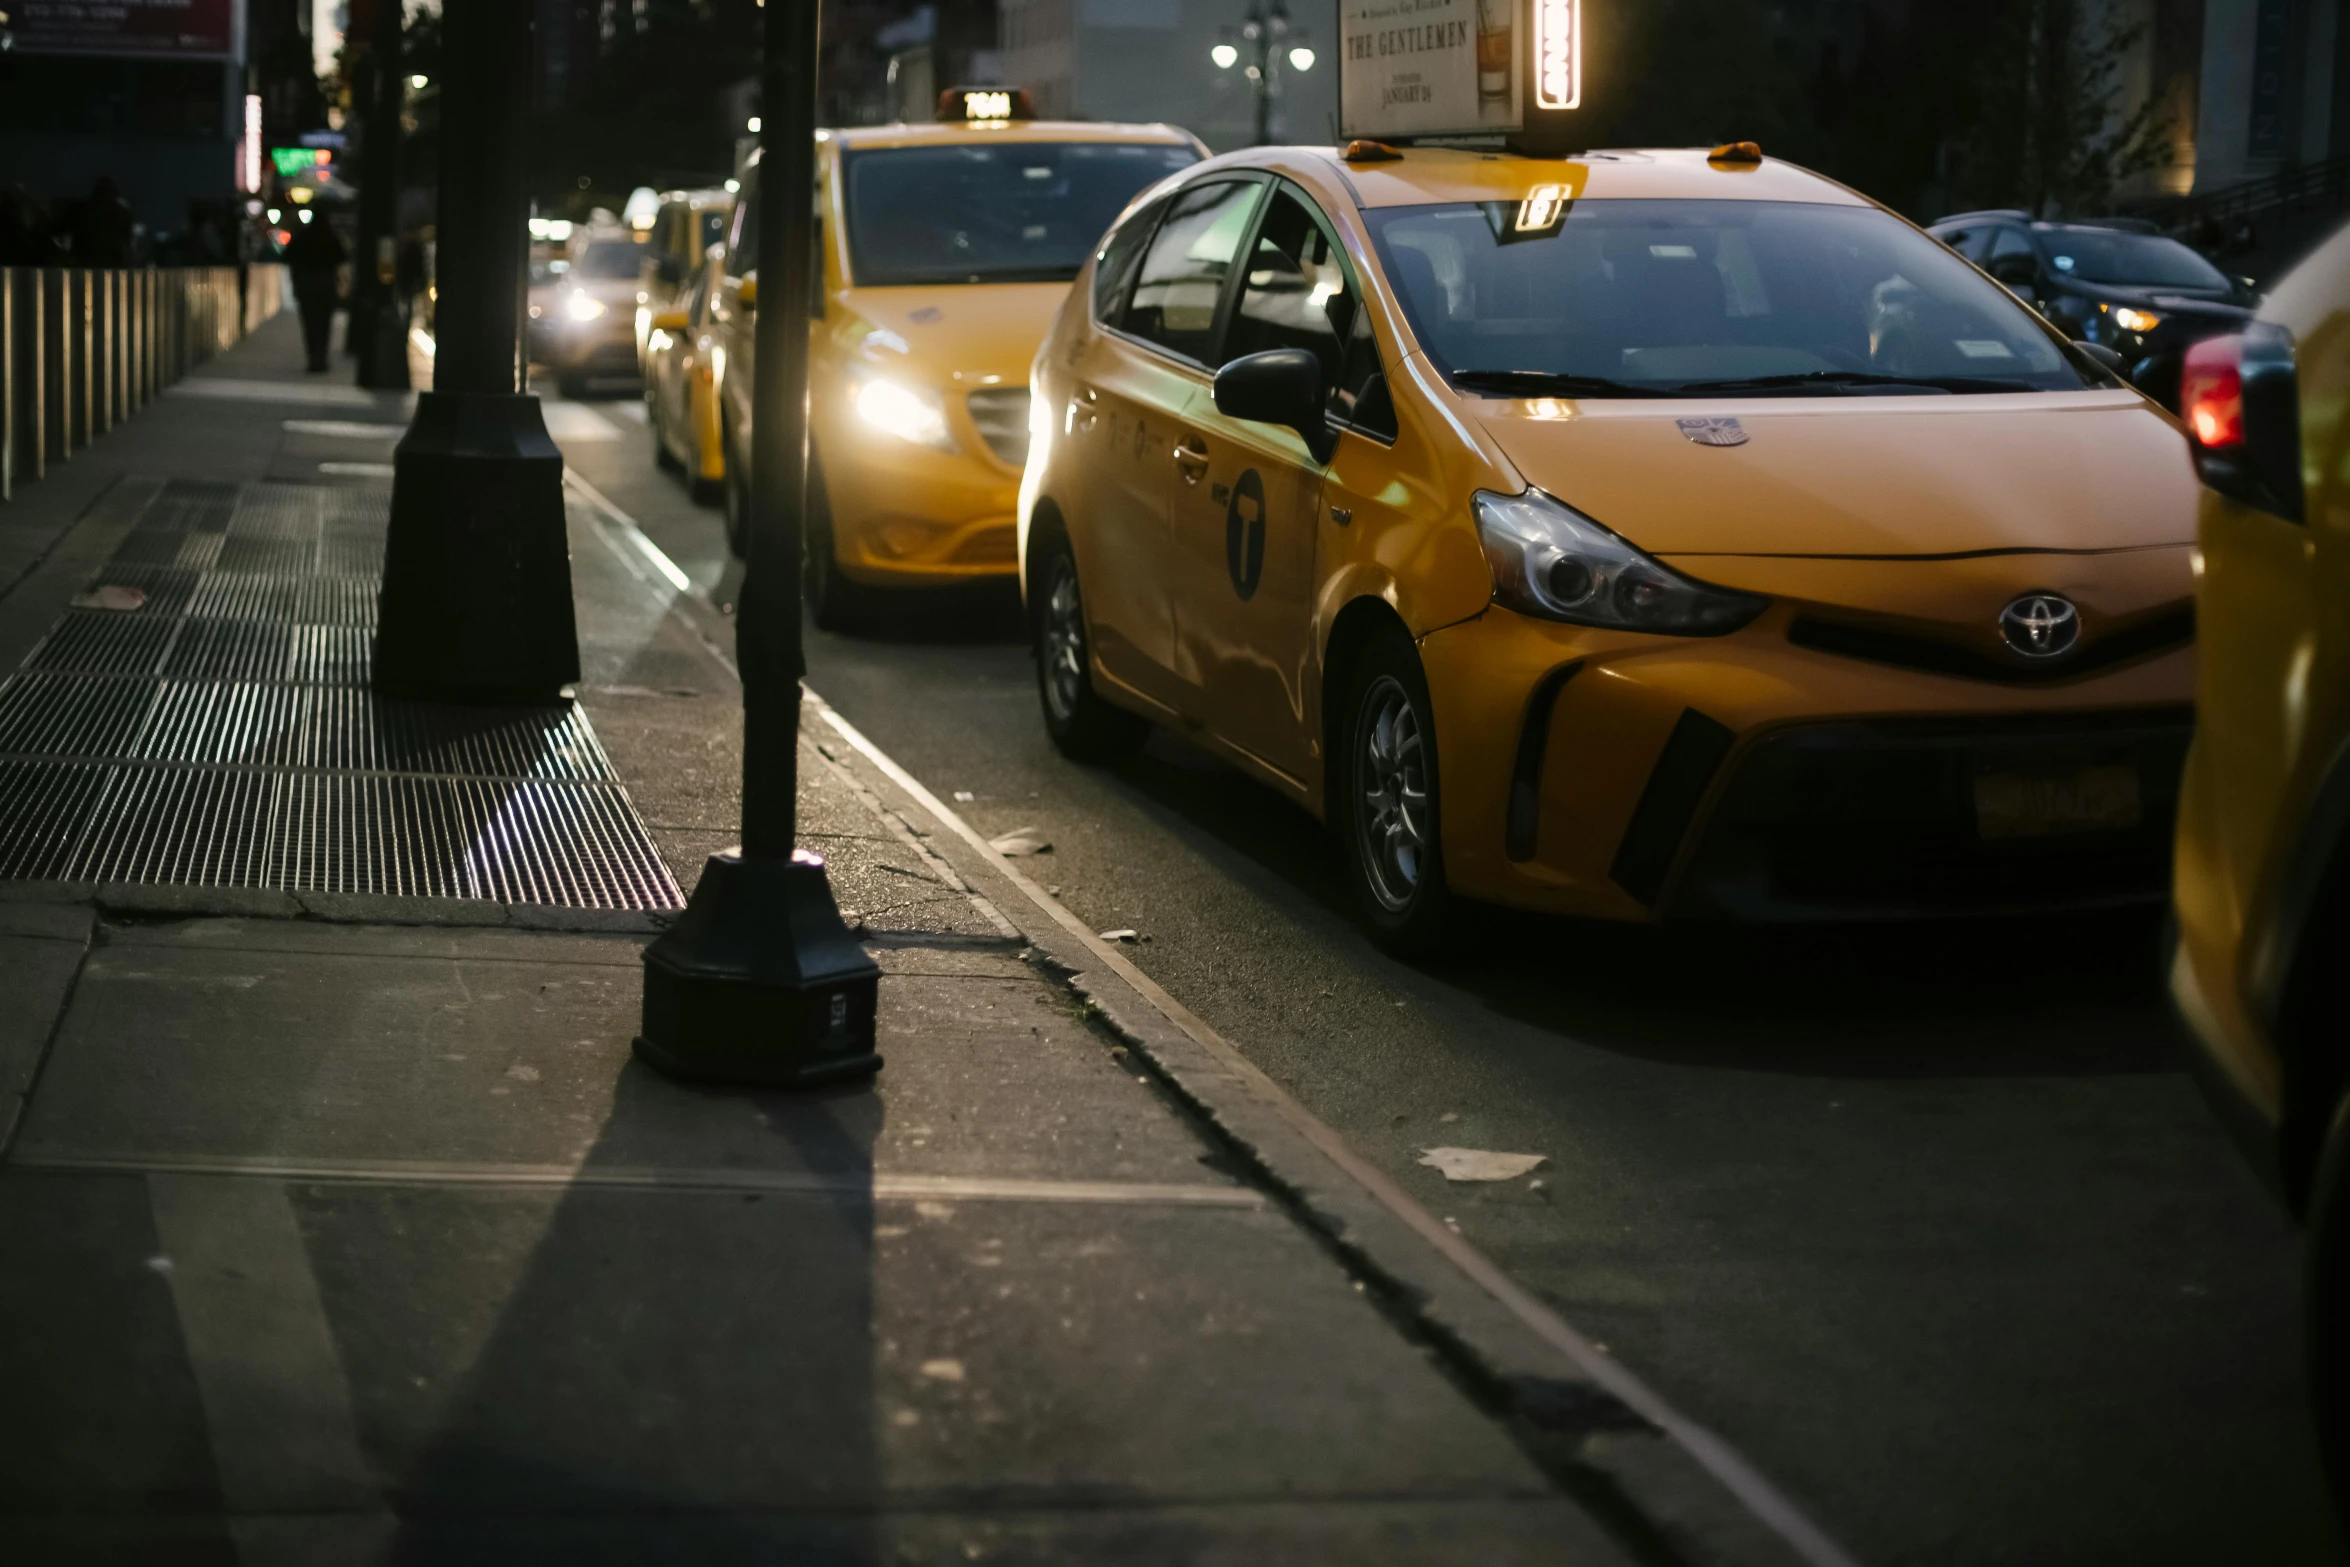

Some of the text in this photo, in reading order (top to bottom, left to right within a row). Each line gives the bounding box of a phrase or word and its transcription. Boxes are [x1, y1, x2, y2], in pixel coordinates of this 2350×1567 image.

[1347, 20, 1467, 60] THE GENTLEMEN
[1382, 85, 1419, 110] JANUARY
